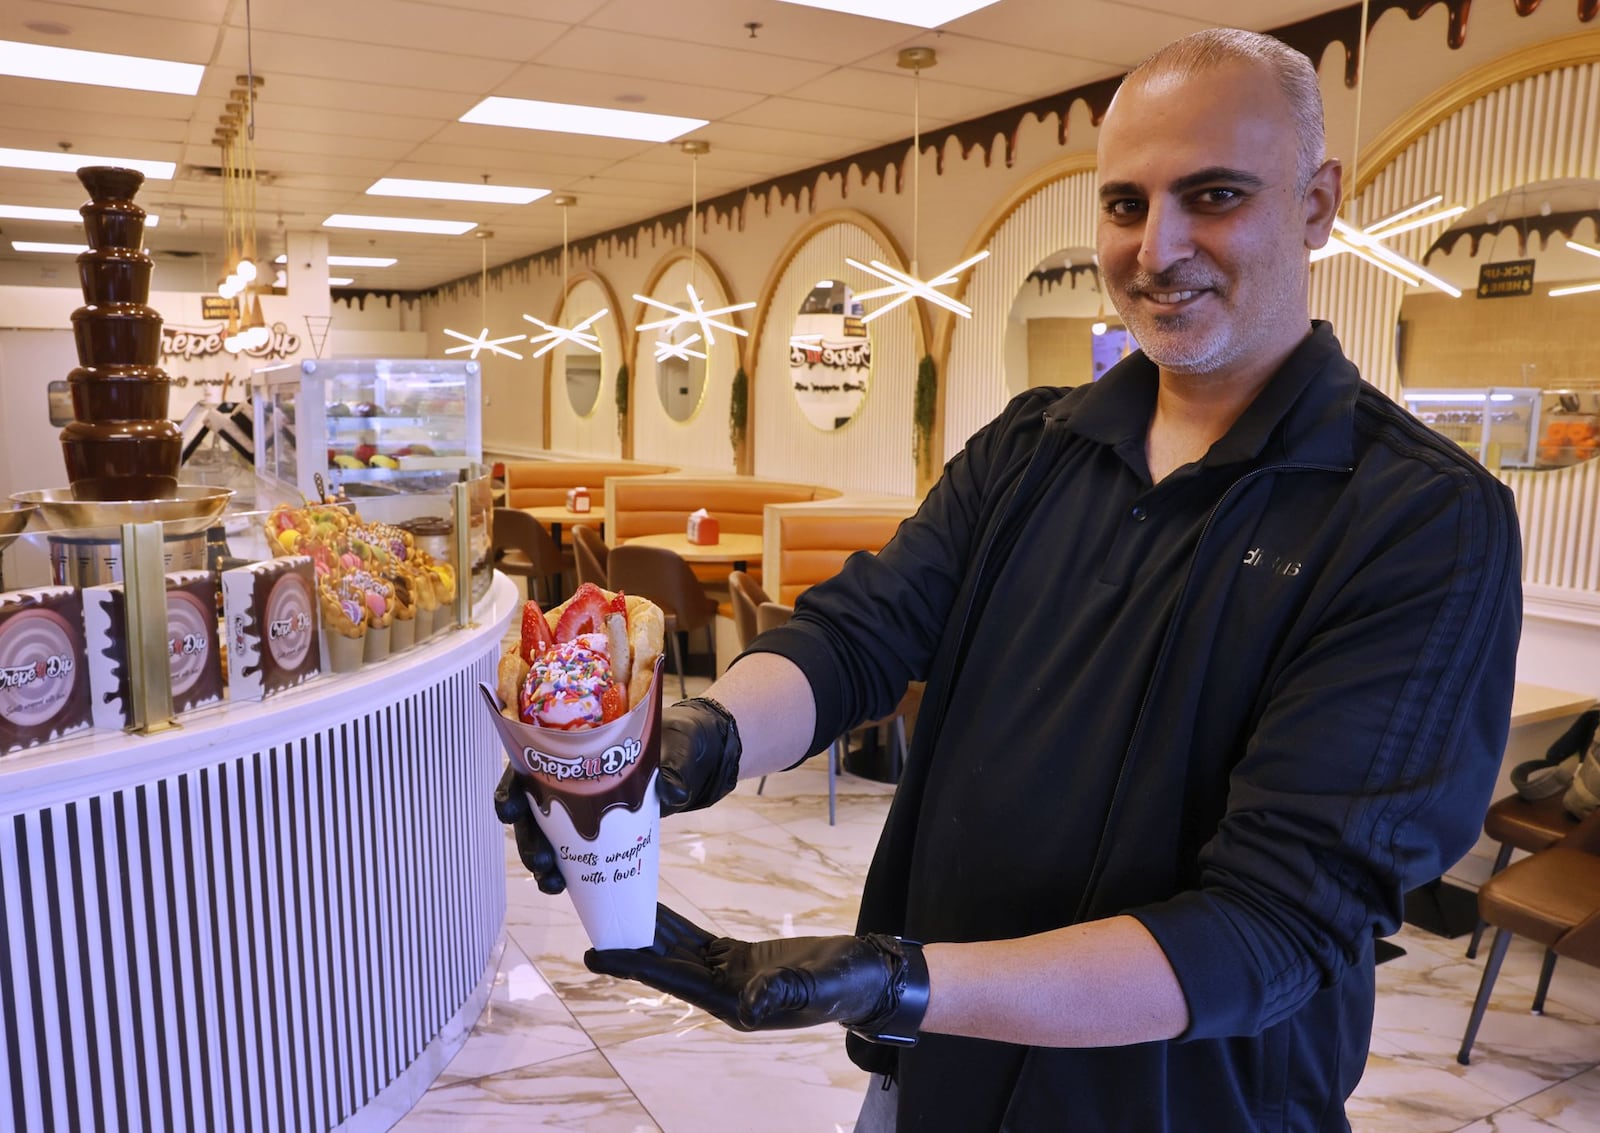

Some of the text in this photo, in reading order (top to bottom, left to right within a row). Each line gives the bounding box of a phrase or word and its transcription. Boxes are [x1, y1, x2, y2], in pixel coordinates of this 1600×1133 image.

[47, 654, 73, 677] Dip
[601, 737, 642, 775] Dip
[559, 828, 653, 867] Sweets wrapped
[581, 870, 607, 885] with
